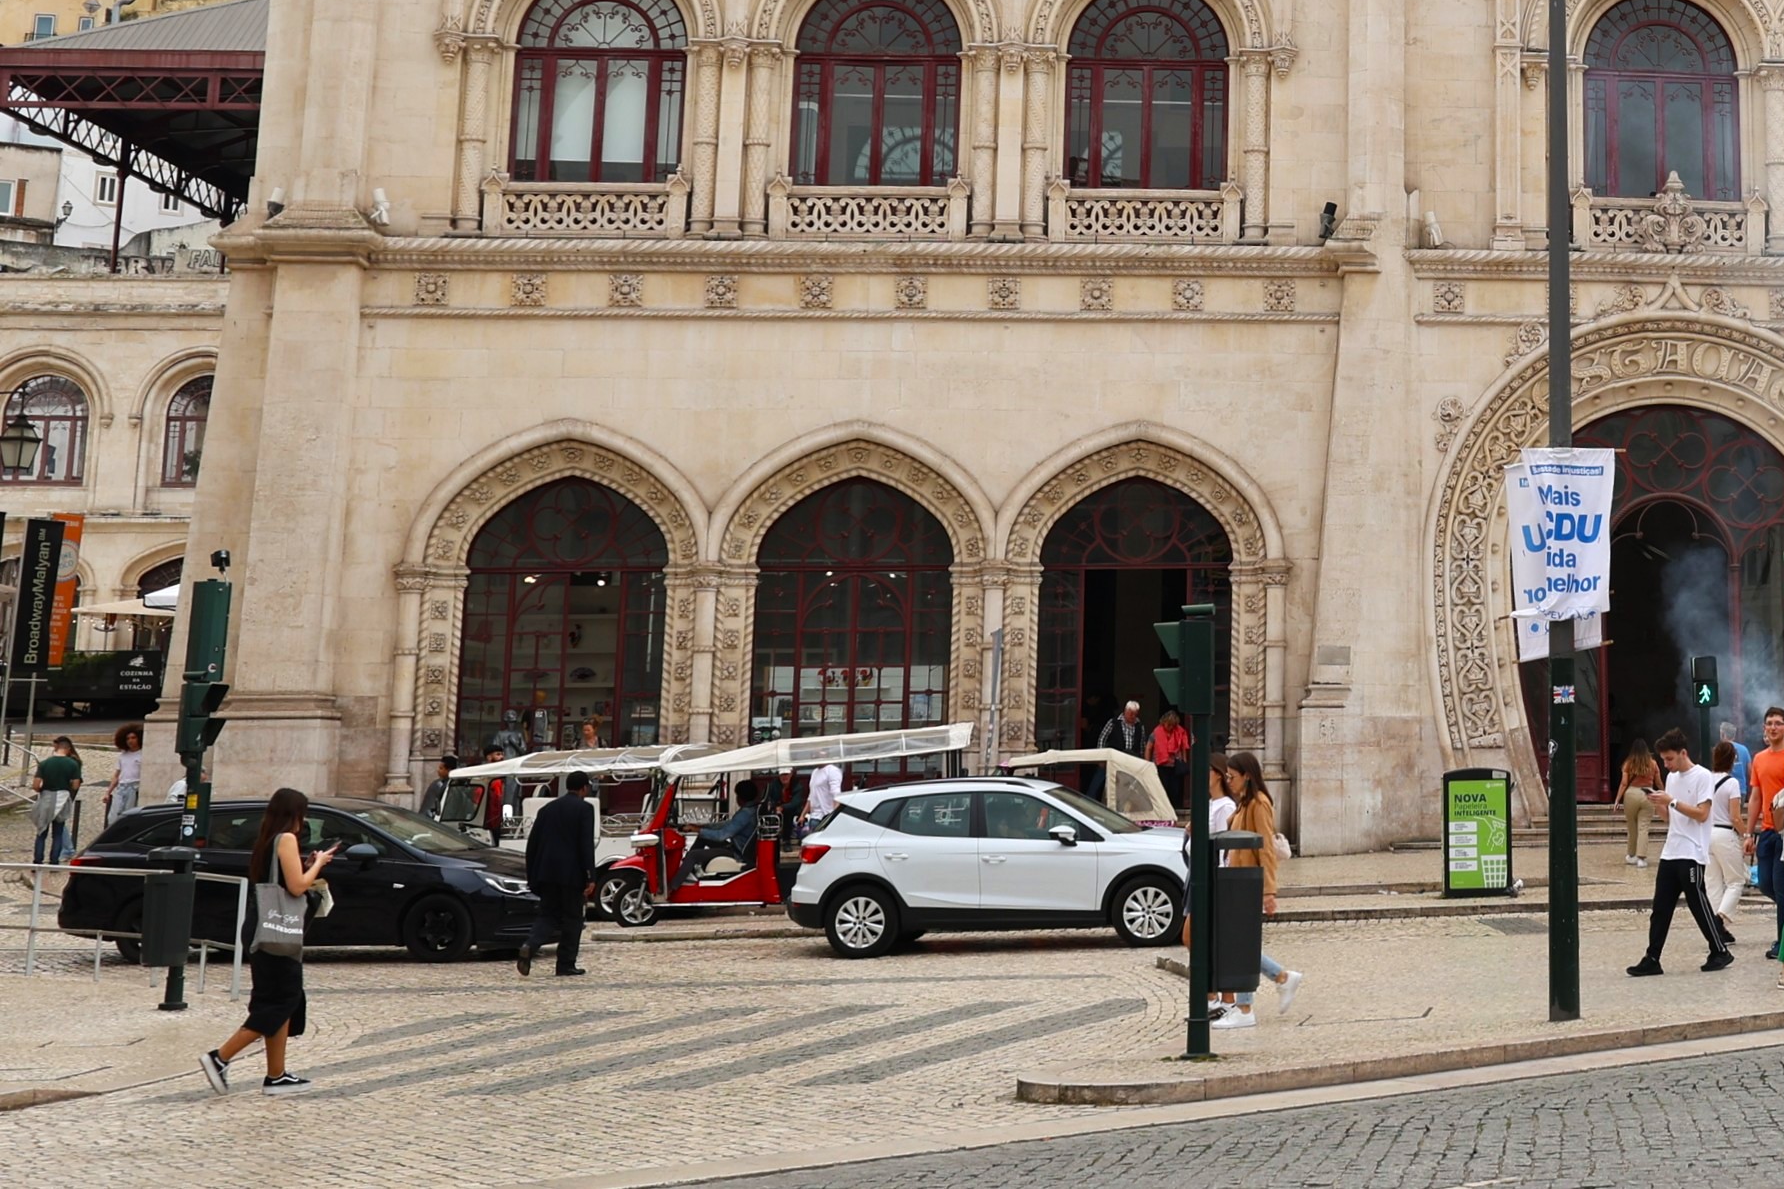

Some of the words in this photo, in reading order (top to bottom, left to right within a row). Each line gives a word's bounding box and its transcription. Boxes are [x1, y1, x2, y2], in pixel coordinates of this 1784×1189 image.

[1537, 485, 1581, 506] Mais
[1546, 545, 1576, 568] ida
[1454, 794, 1487, 803] NOVA
[1454, 803, 1487, 811] Papeleira
